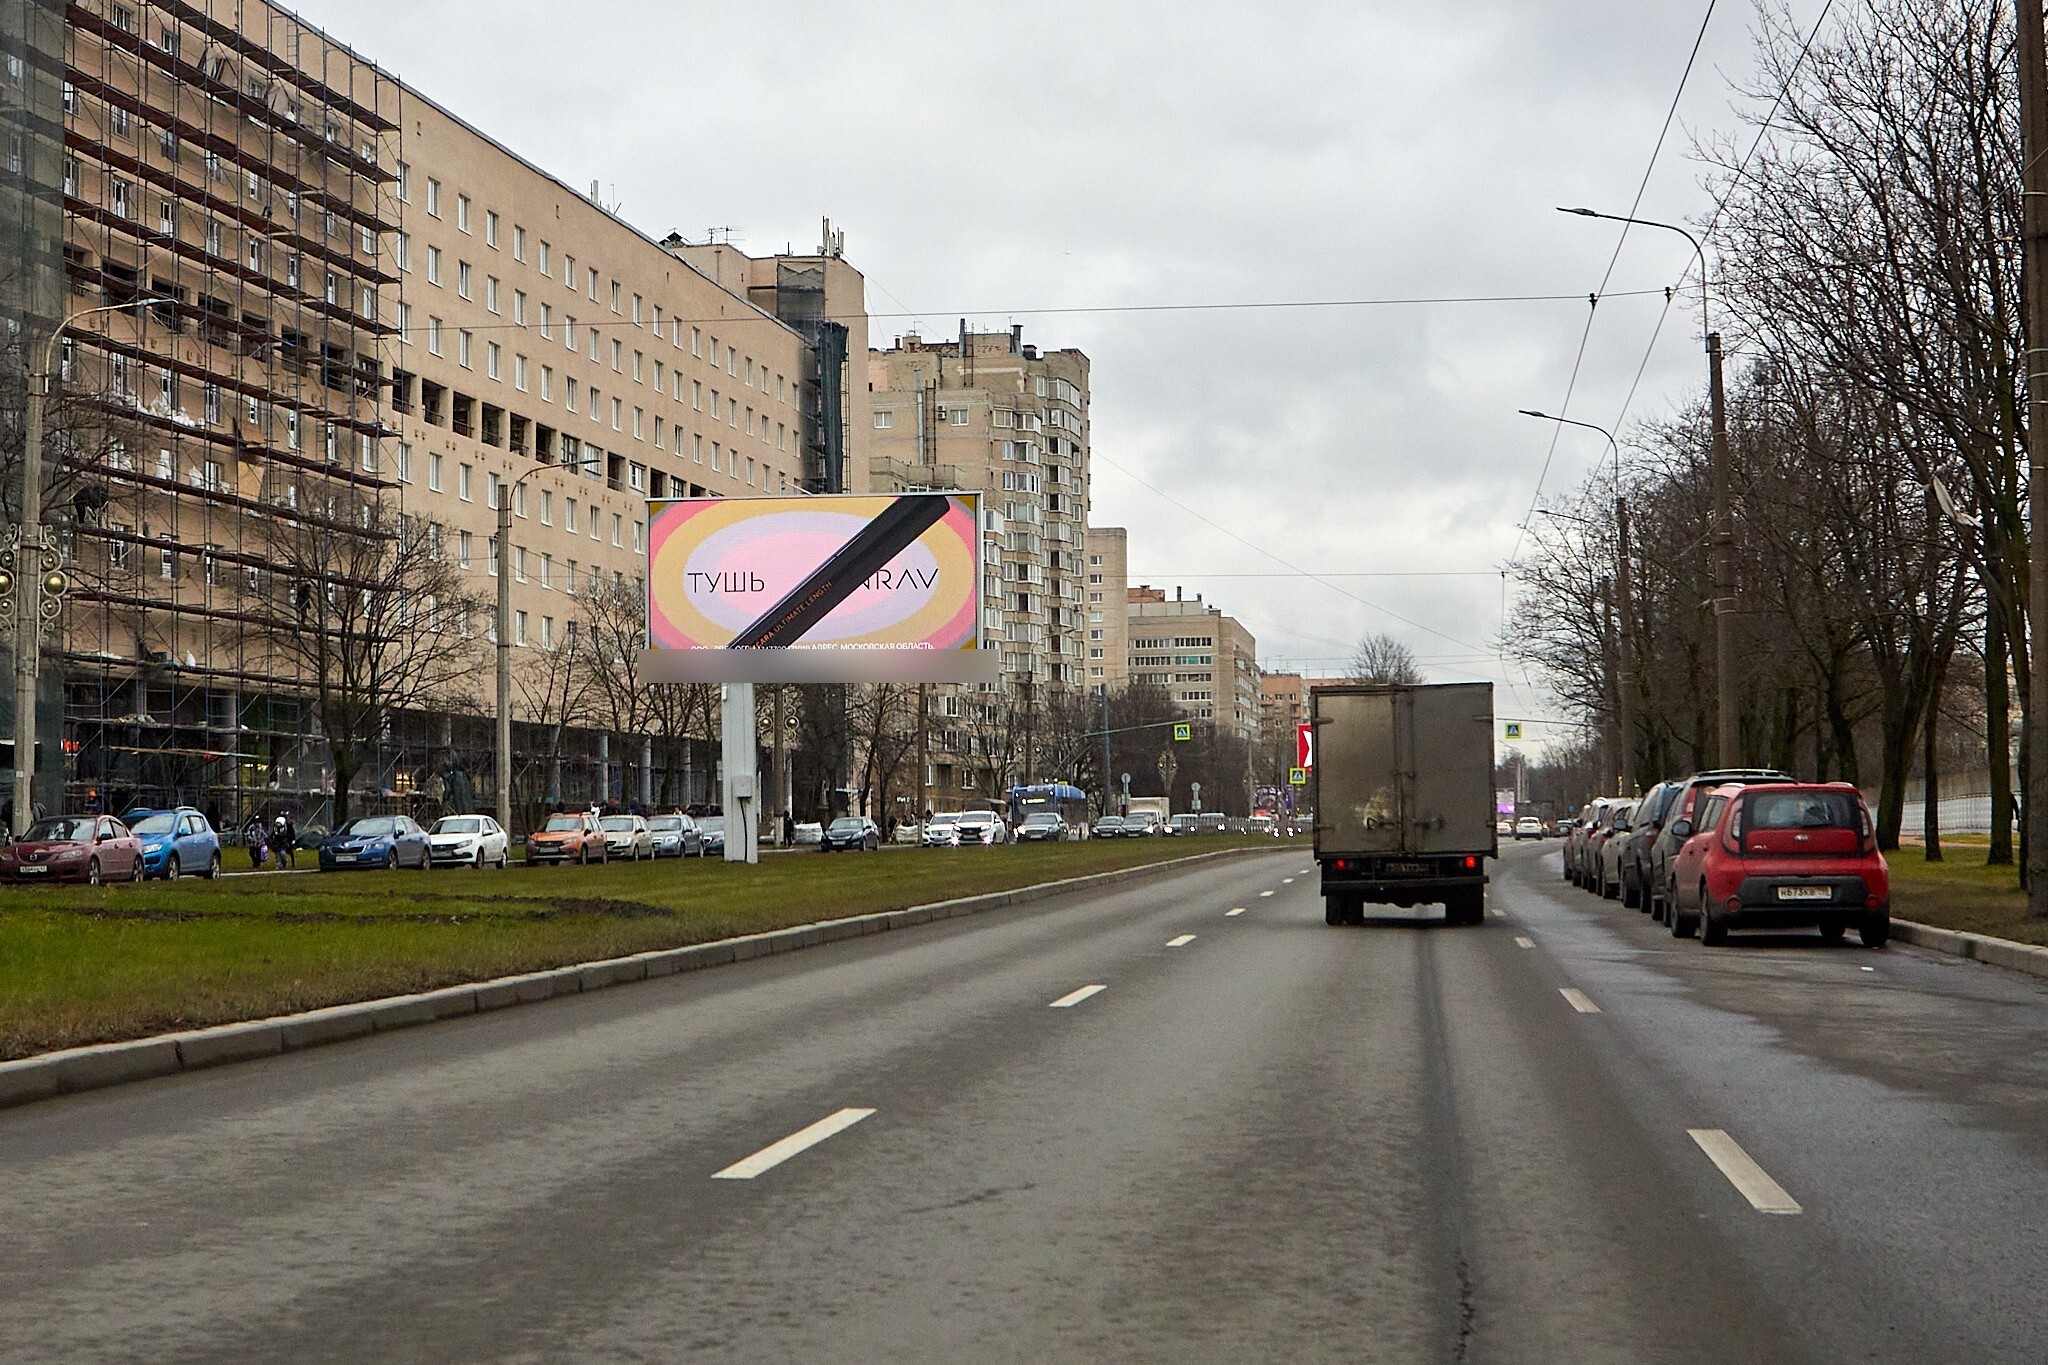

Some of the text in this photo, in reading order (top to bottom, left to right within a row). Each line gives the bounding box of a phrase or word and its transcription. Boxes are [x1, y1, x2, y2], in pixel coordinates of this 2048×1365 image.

[687, 571, 765, 593] ТУШЬ
[773, 604, 806, 633] ULTIMATE
[805, 580, 833, 606] LENGTH
